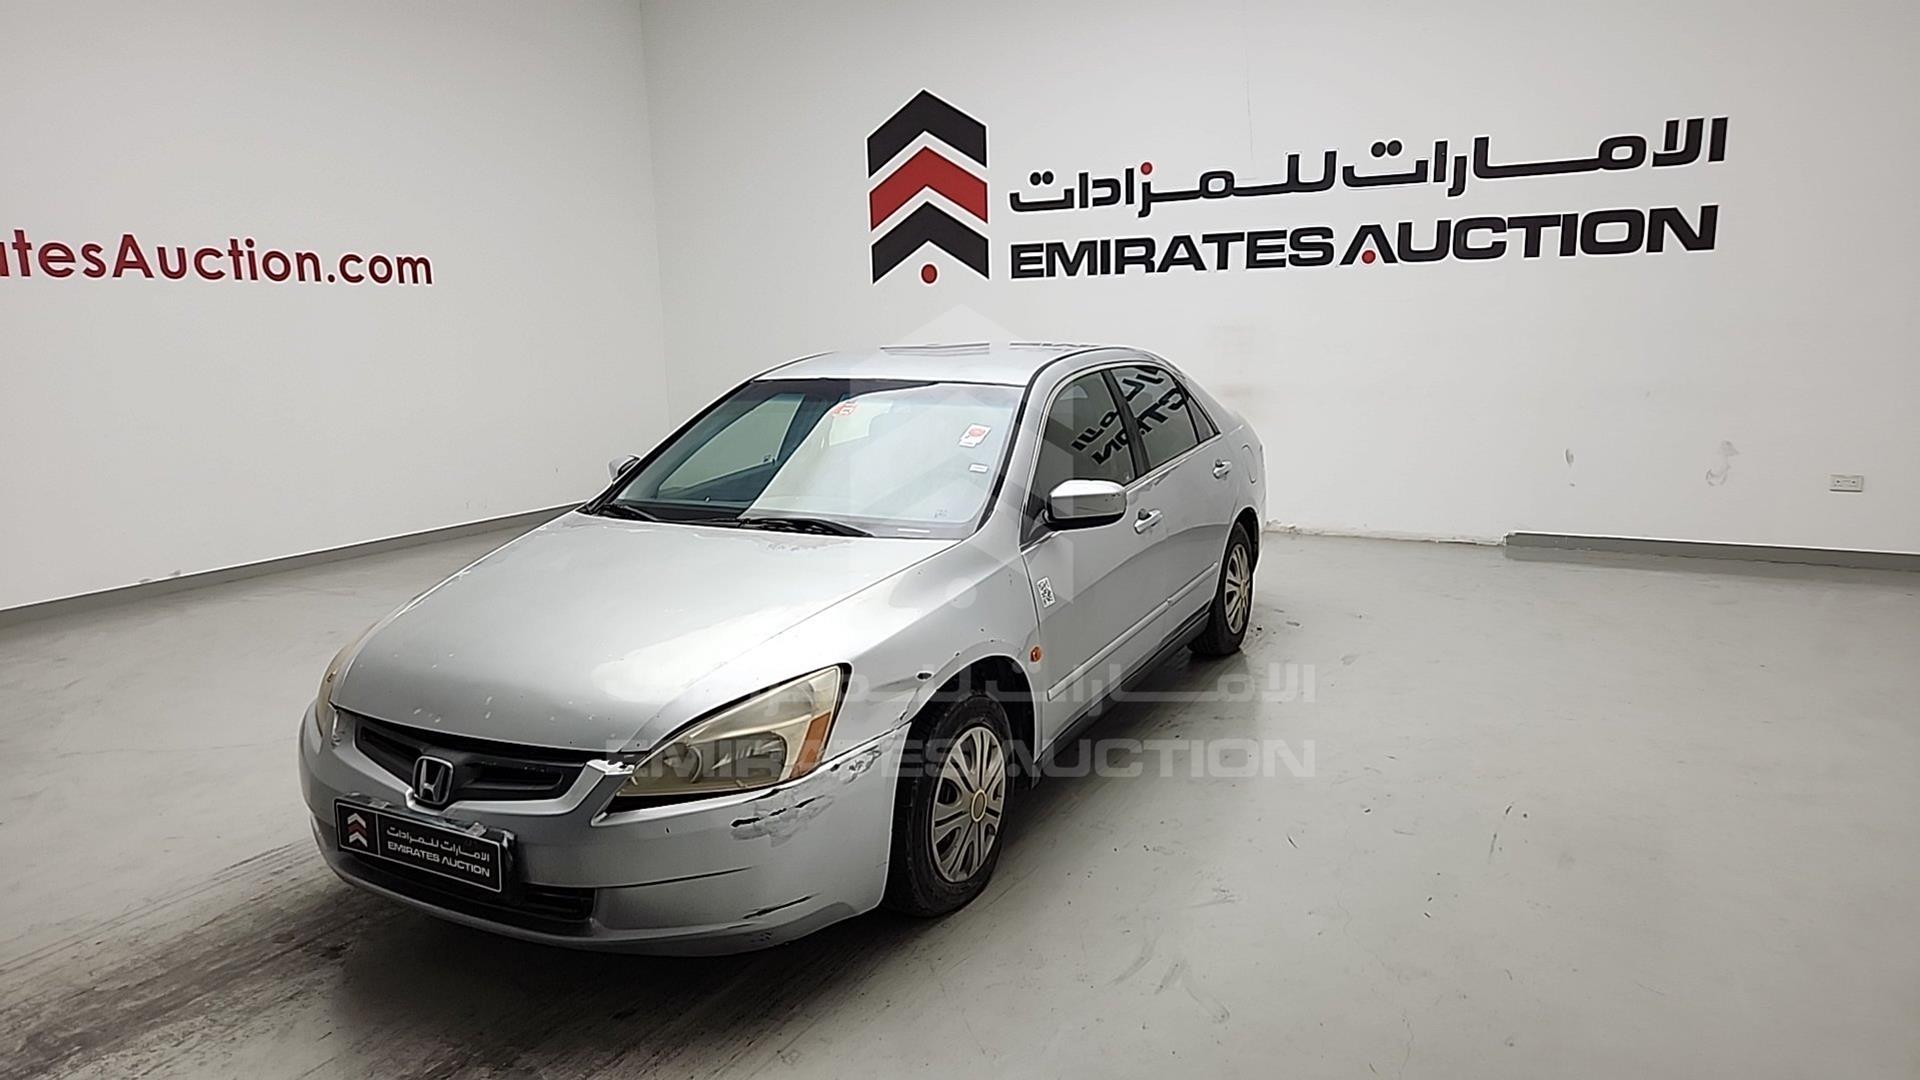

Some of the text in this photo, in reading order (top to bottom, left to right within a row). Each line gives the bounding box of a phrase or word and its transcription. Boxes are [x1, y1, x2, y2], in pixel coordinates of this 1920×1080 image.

[1009, 150, 1337, 219] للمزادات
[1010, 204, 1719, 279] EMIRATES AUCTION
[387, 841, 490, 878] EMIRATES AUCTION
